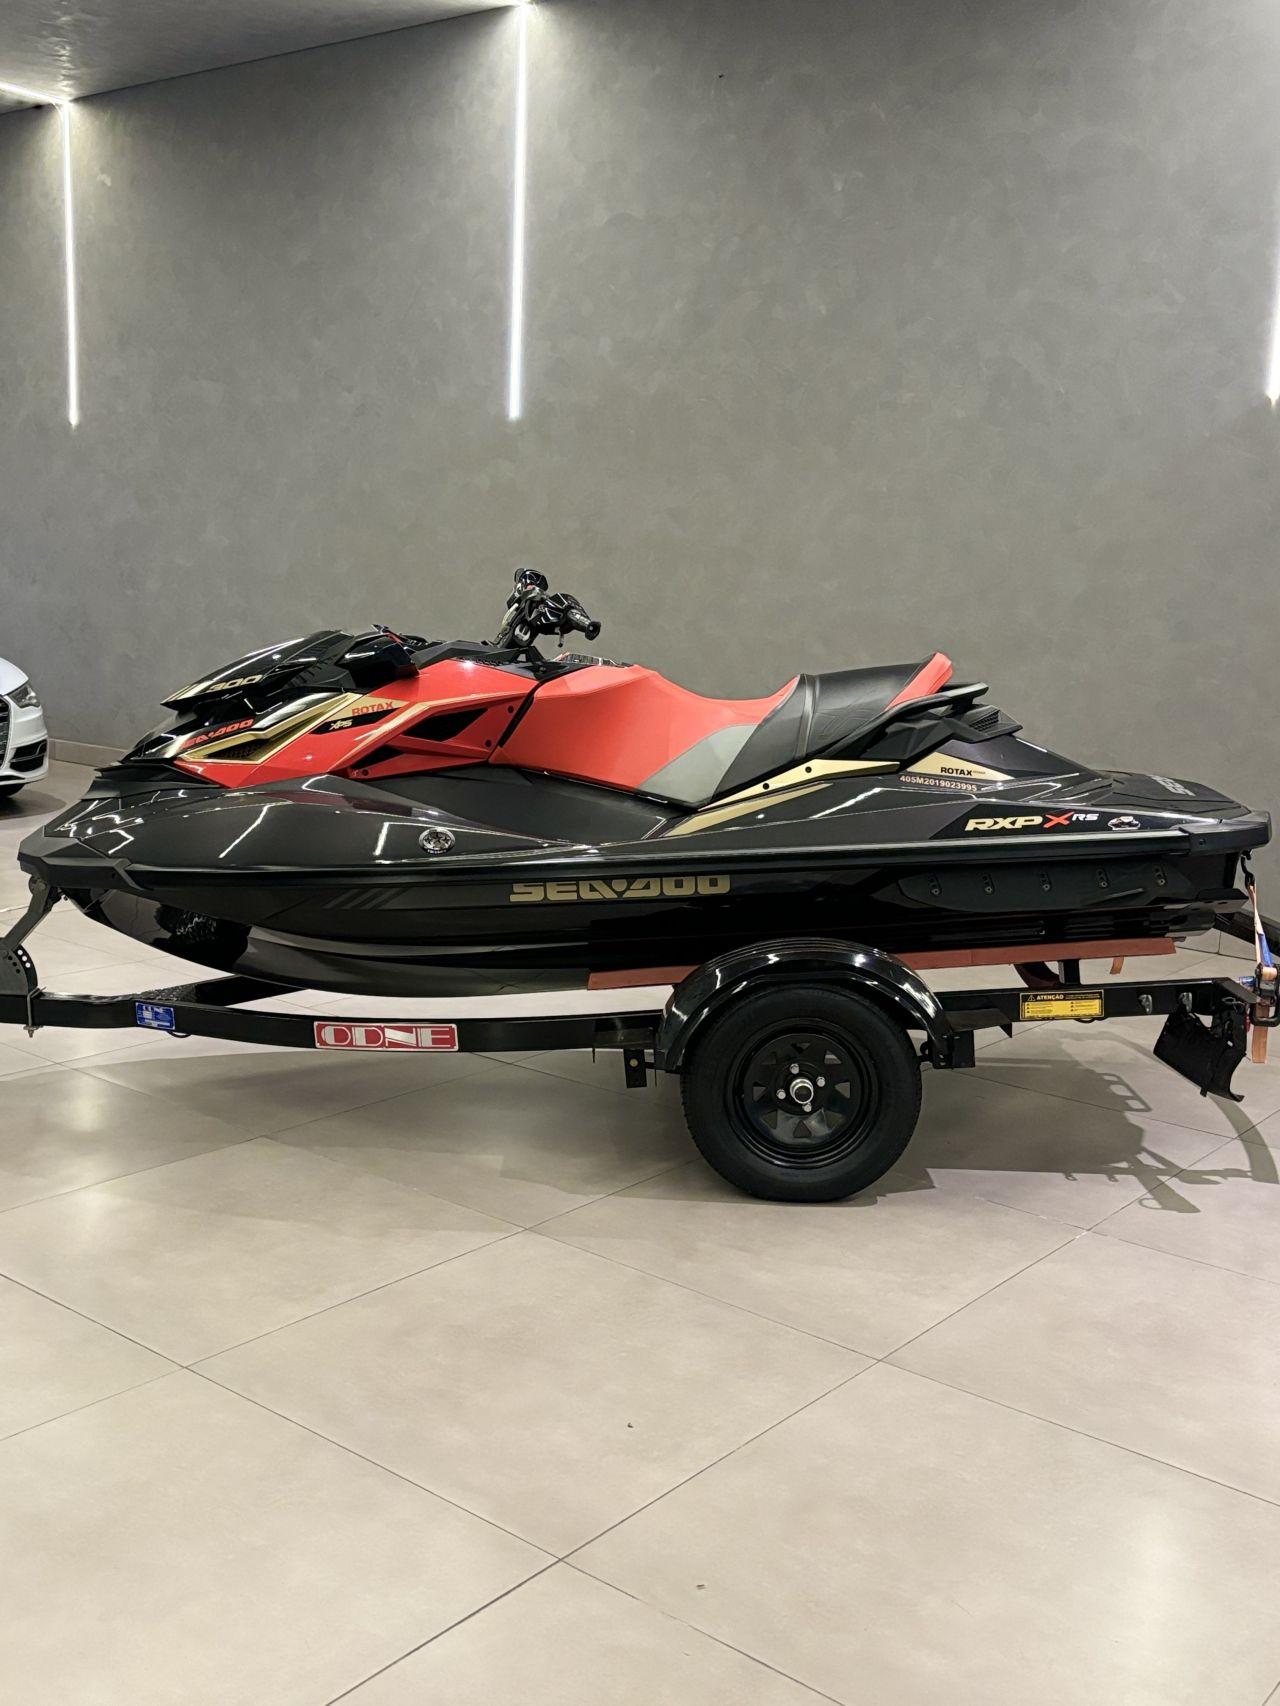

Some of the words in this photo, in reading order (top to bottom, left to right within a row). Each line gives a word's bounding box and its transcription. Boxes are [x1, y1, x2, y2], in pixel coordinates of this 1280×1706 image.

[351, 701, 394, 717] ROTAX
[940, 766, 973, 776] ROTAX
[964, 815, 1044, 832] RXP
[1071, 813, 1100, 822] RS
[1036, 993, 1065, 1001] ATENÇÃO
